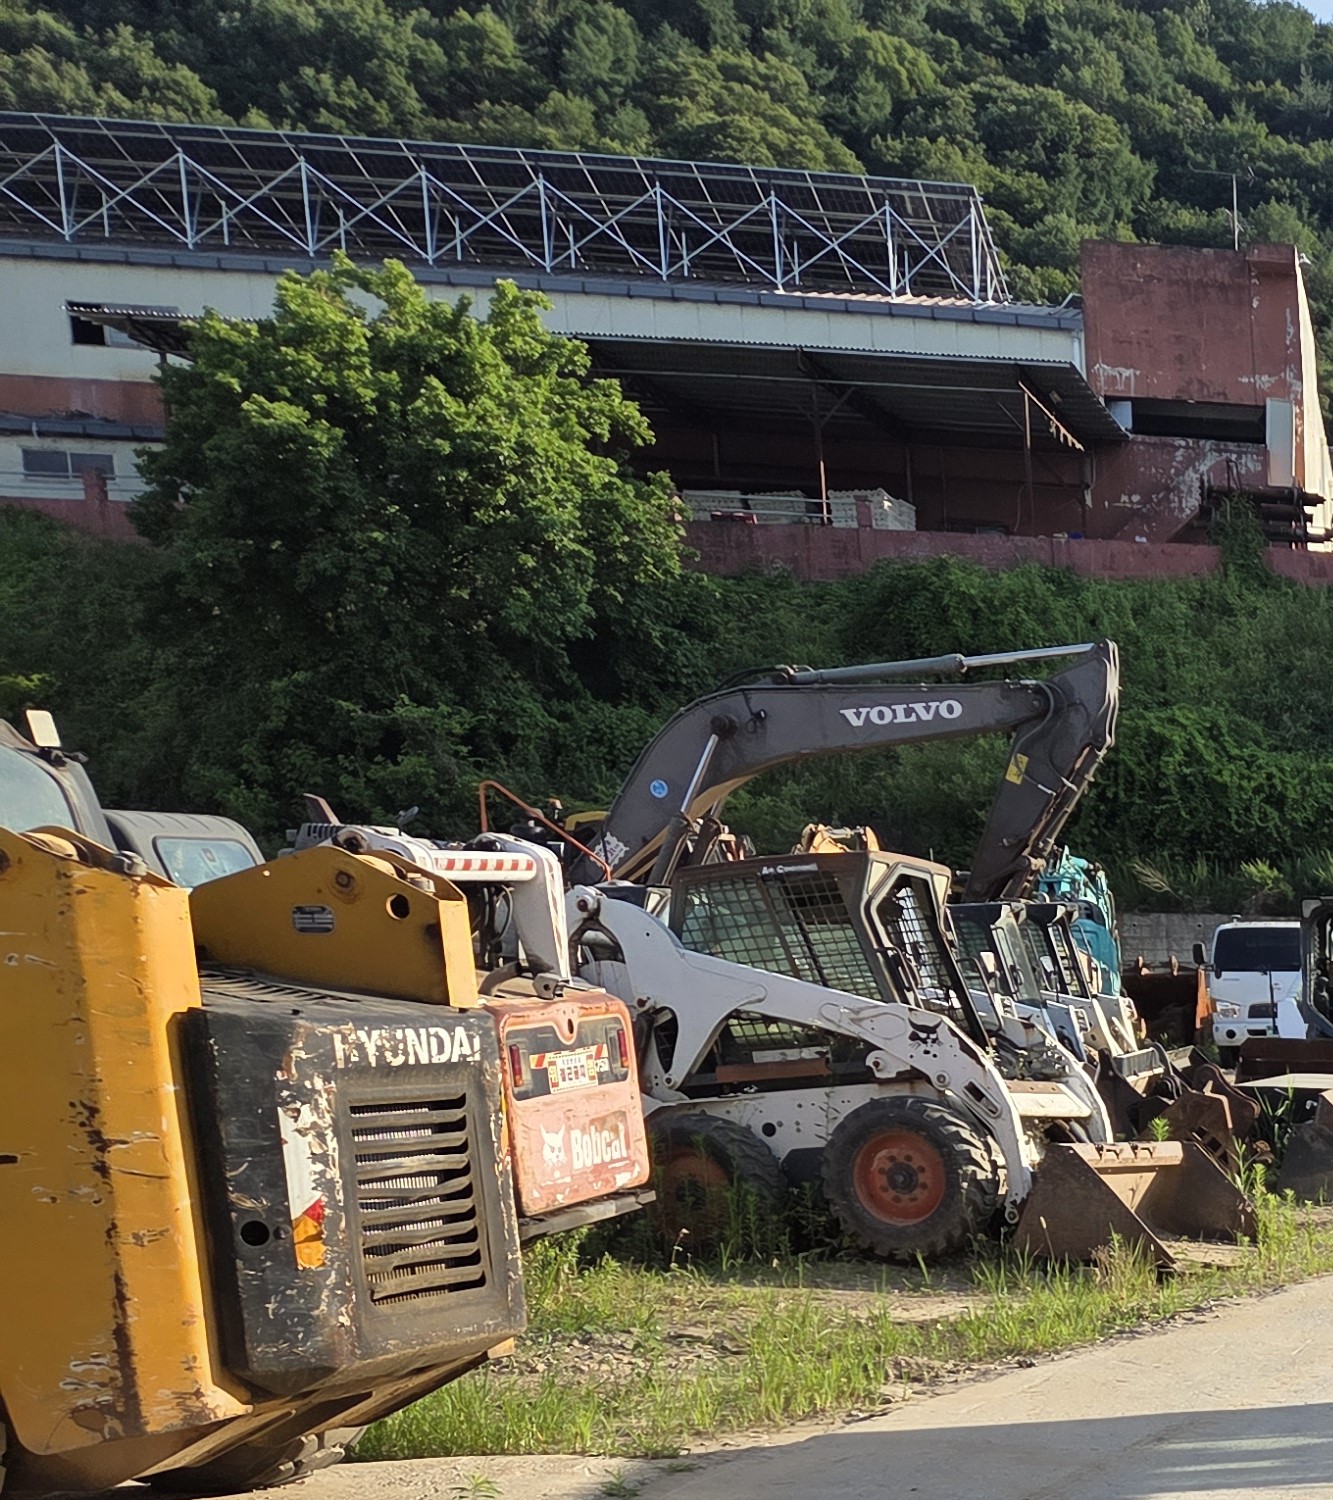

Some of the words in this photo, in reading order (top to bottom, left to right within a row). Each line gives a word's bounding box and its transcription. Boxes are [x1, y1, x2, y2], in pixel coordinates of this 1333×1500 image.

[840, 700, 962, 726] VOLVO
[333, 1026, 481, 1068] HYUNDAI
[570, 1121, 628, 1170] Bobcat
